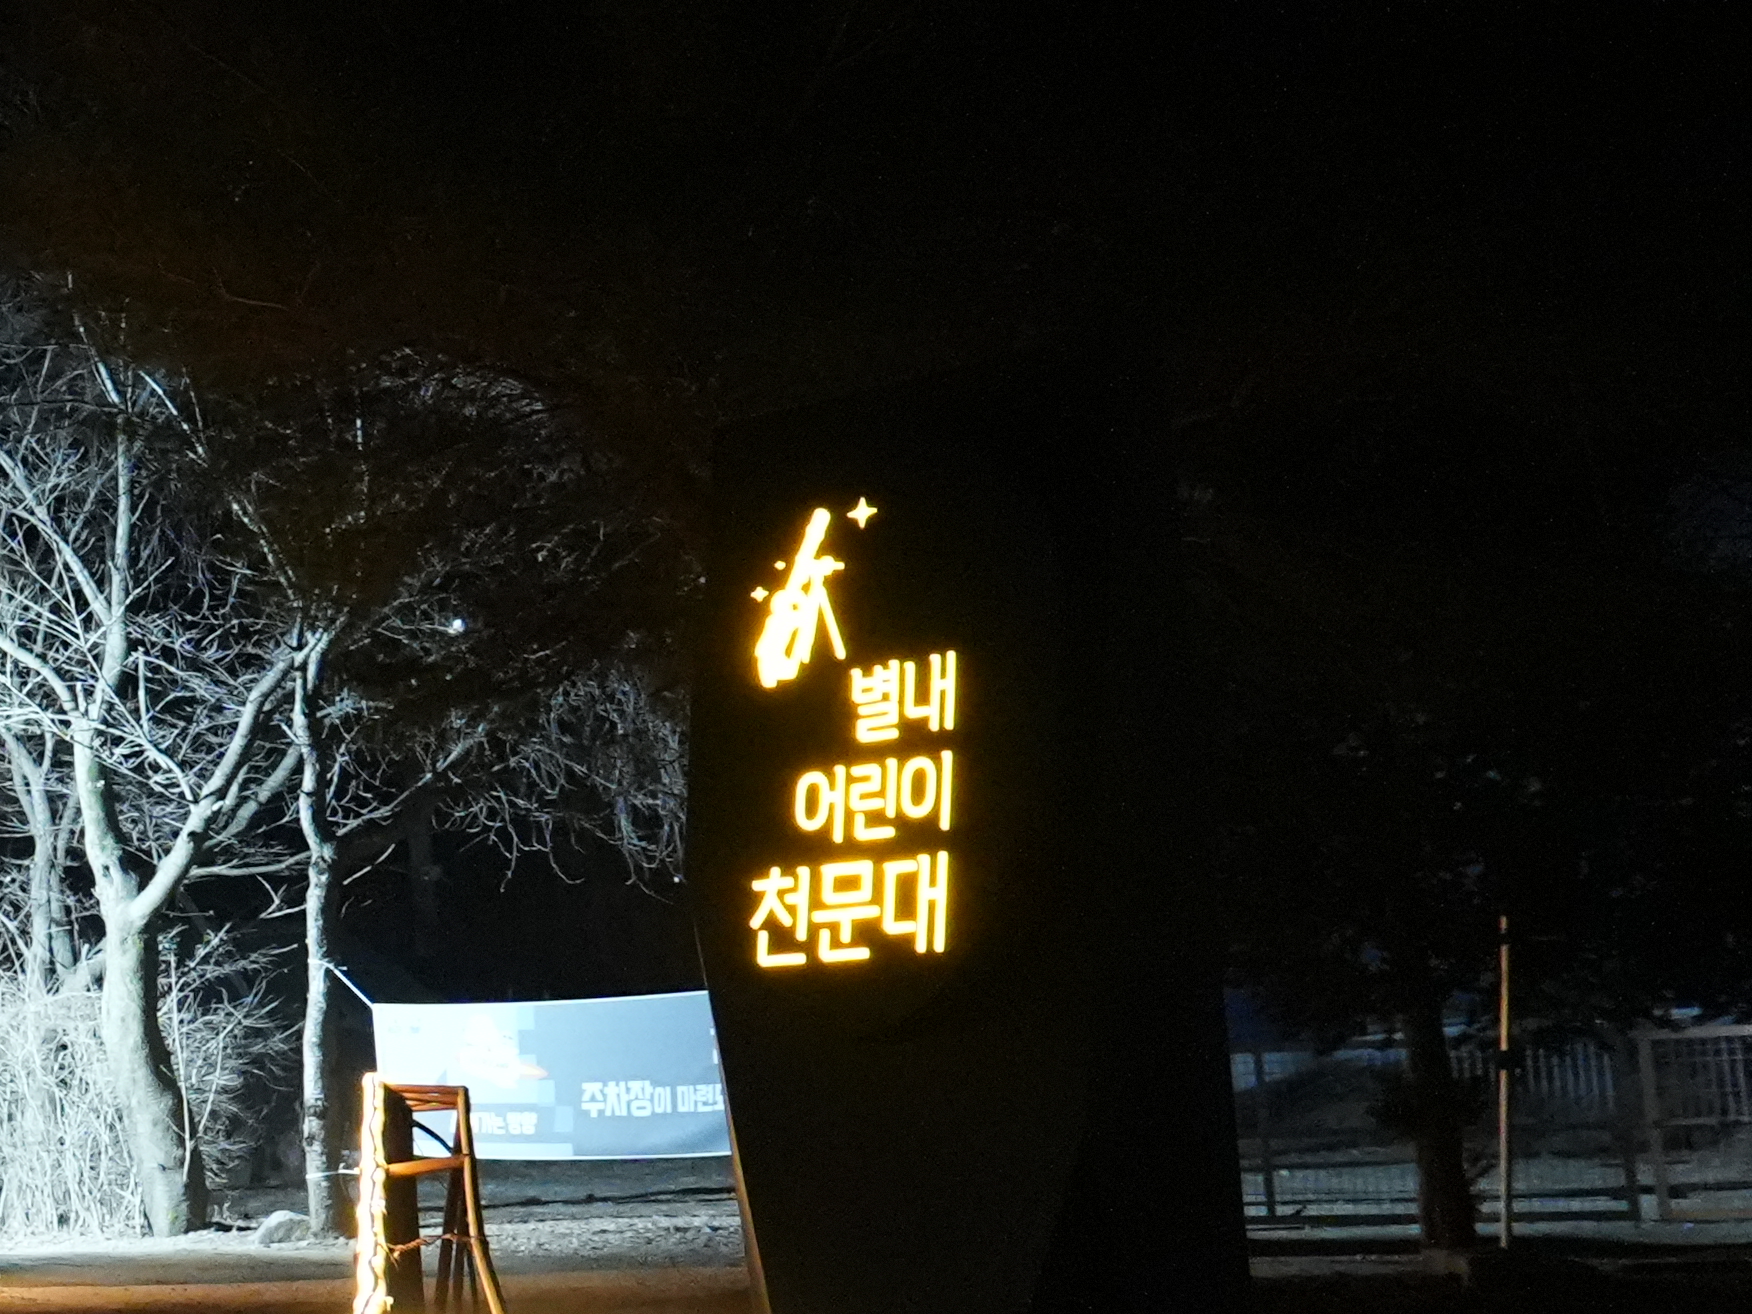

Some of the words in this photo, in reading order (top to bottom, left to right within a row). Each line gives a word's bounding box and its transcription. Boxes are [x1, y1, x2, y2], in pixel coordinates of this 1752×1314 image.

[849, 649, 957, 744] 별내
[793, 749, 954, 844] 어린이
[748, 850, 950, 969] 천문대
[580, 1080, 673, 1118] 주차장이
